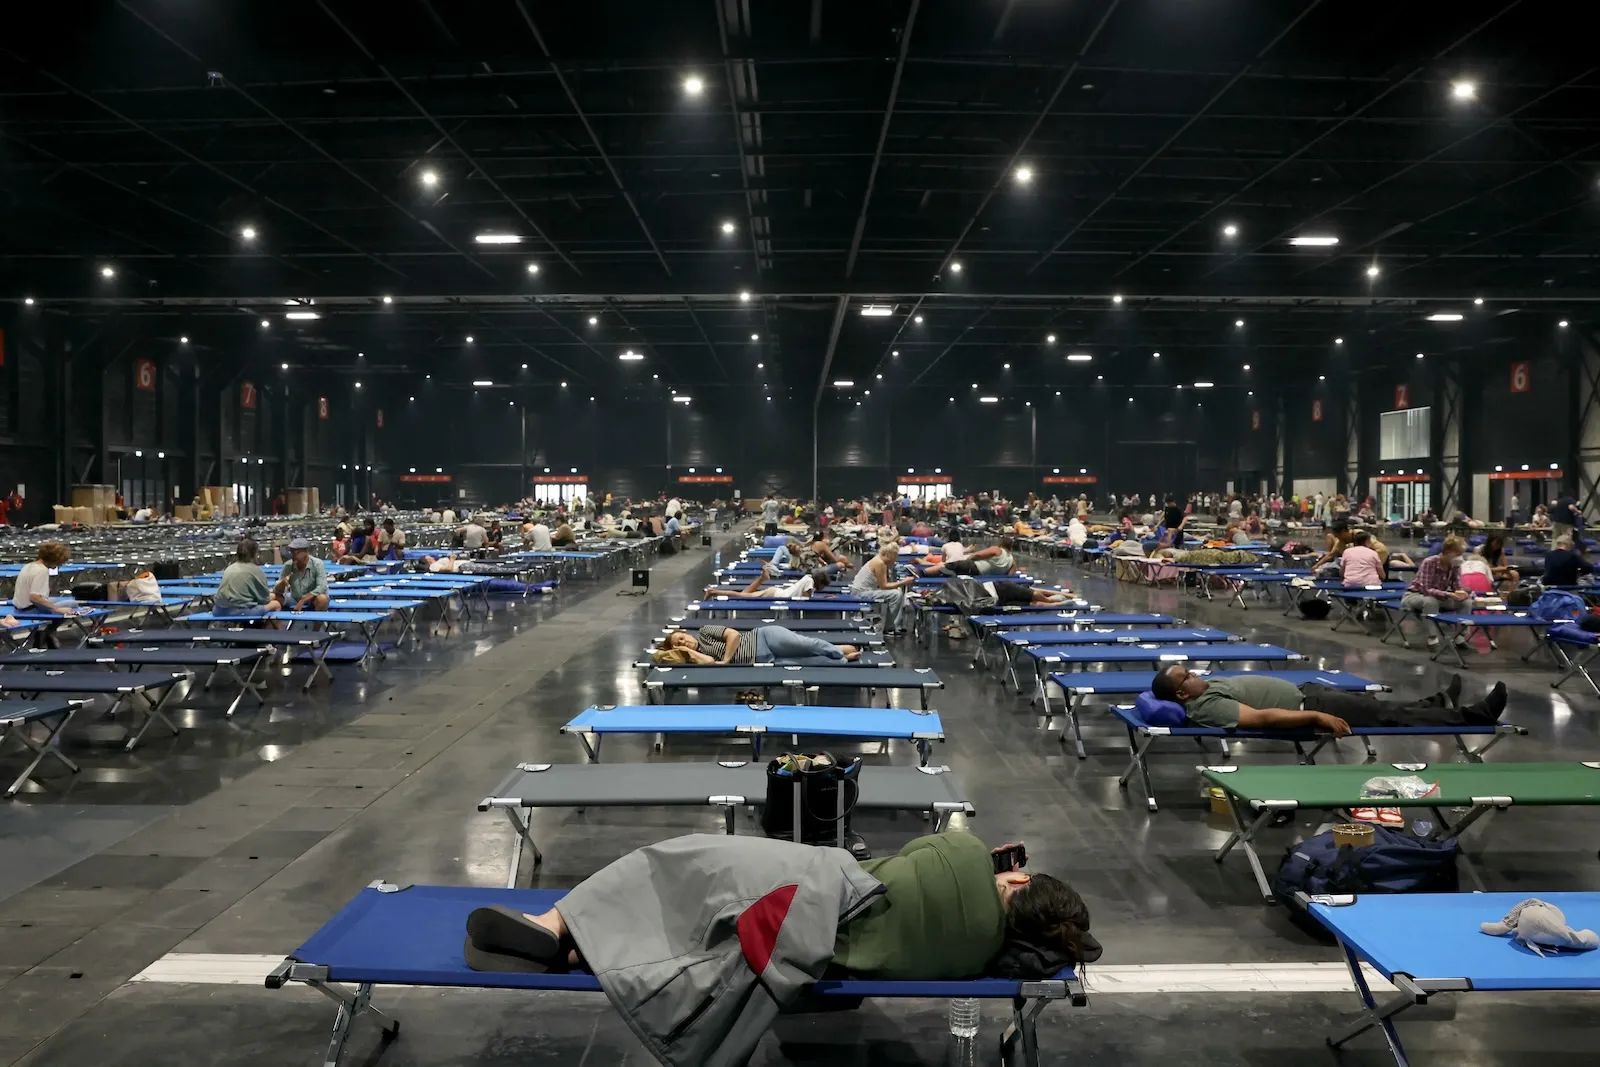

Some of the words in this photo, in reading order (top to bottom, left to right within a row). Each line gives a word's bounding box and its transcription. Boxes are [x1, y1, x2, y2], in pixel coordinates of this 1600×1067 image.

[141, 362, 151, 387] 6
[1515, 364, 1526, 389] 6
[244, 383, 254, 405] 7
[320, 397, 327, 416] 8
[1314, 400, 1321, 419] 8
